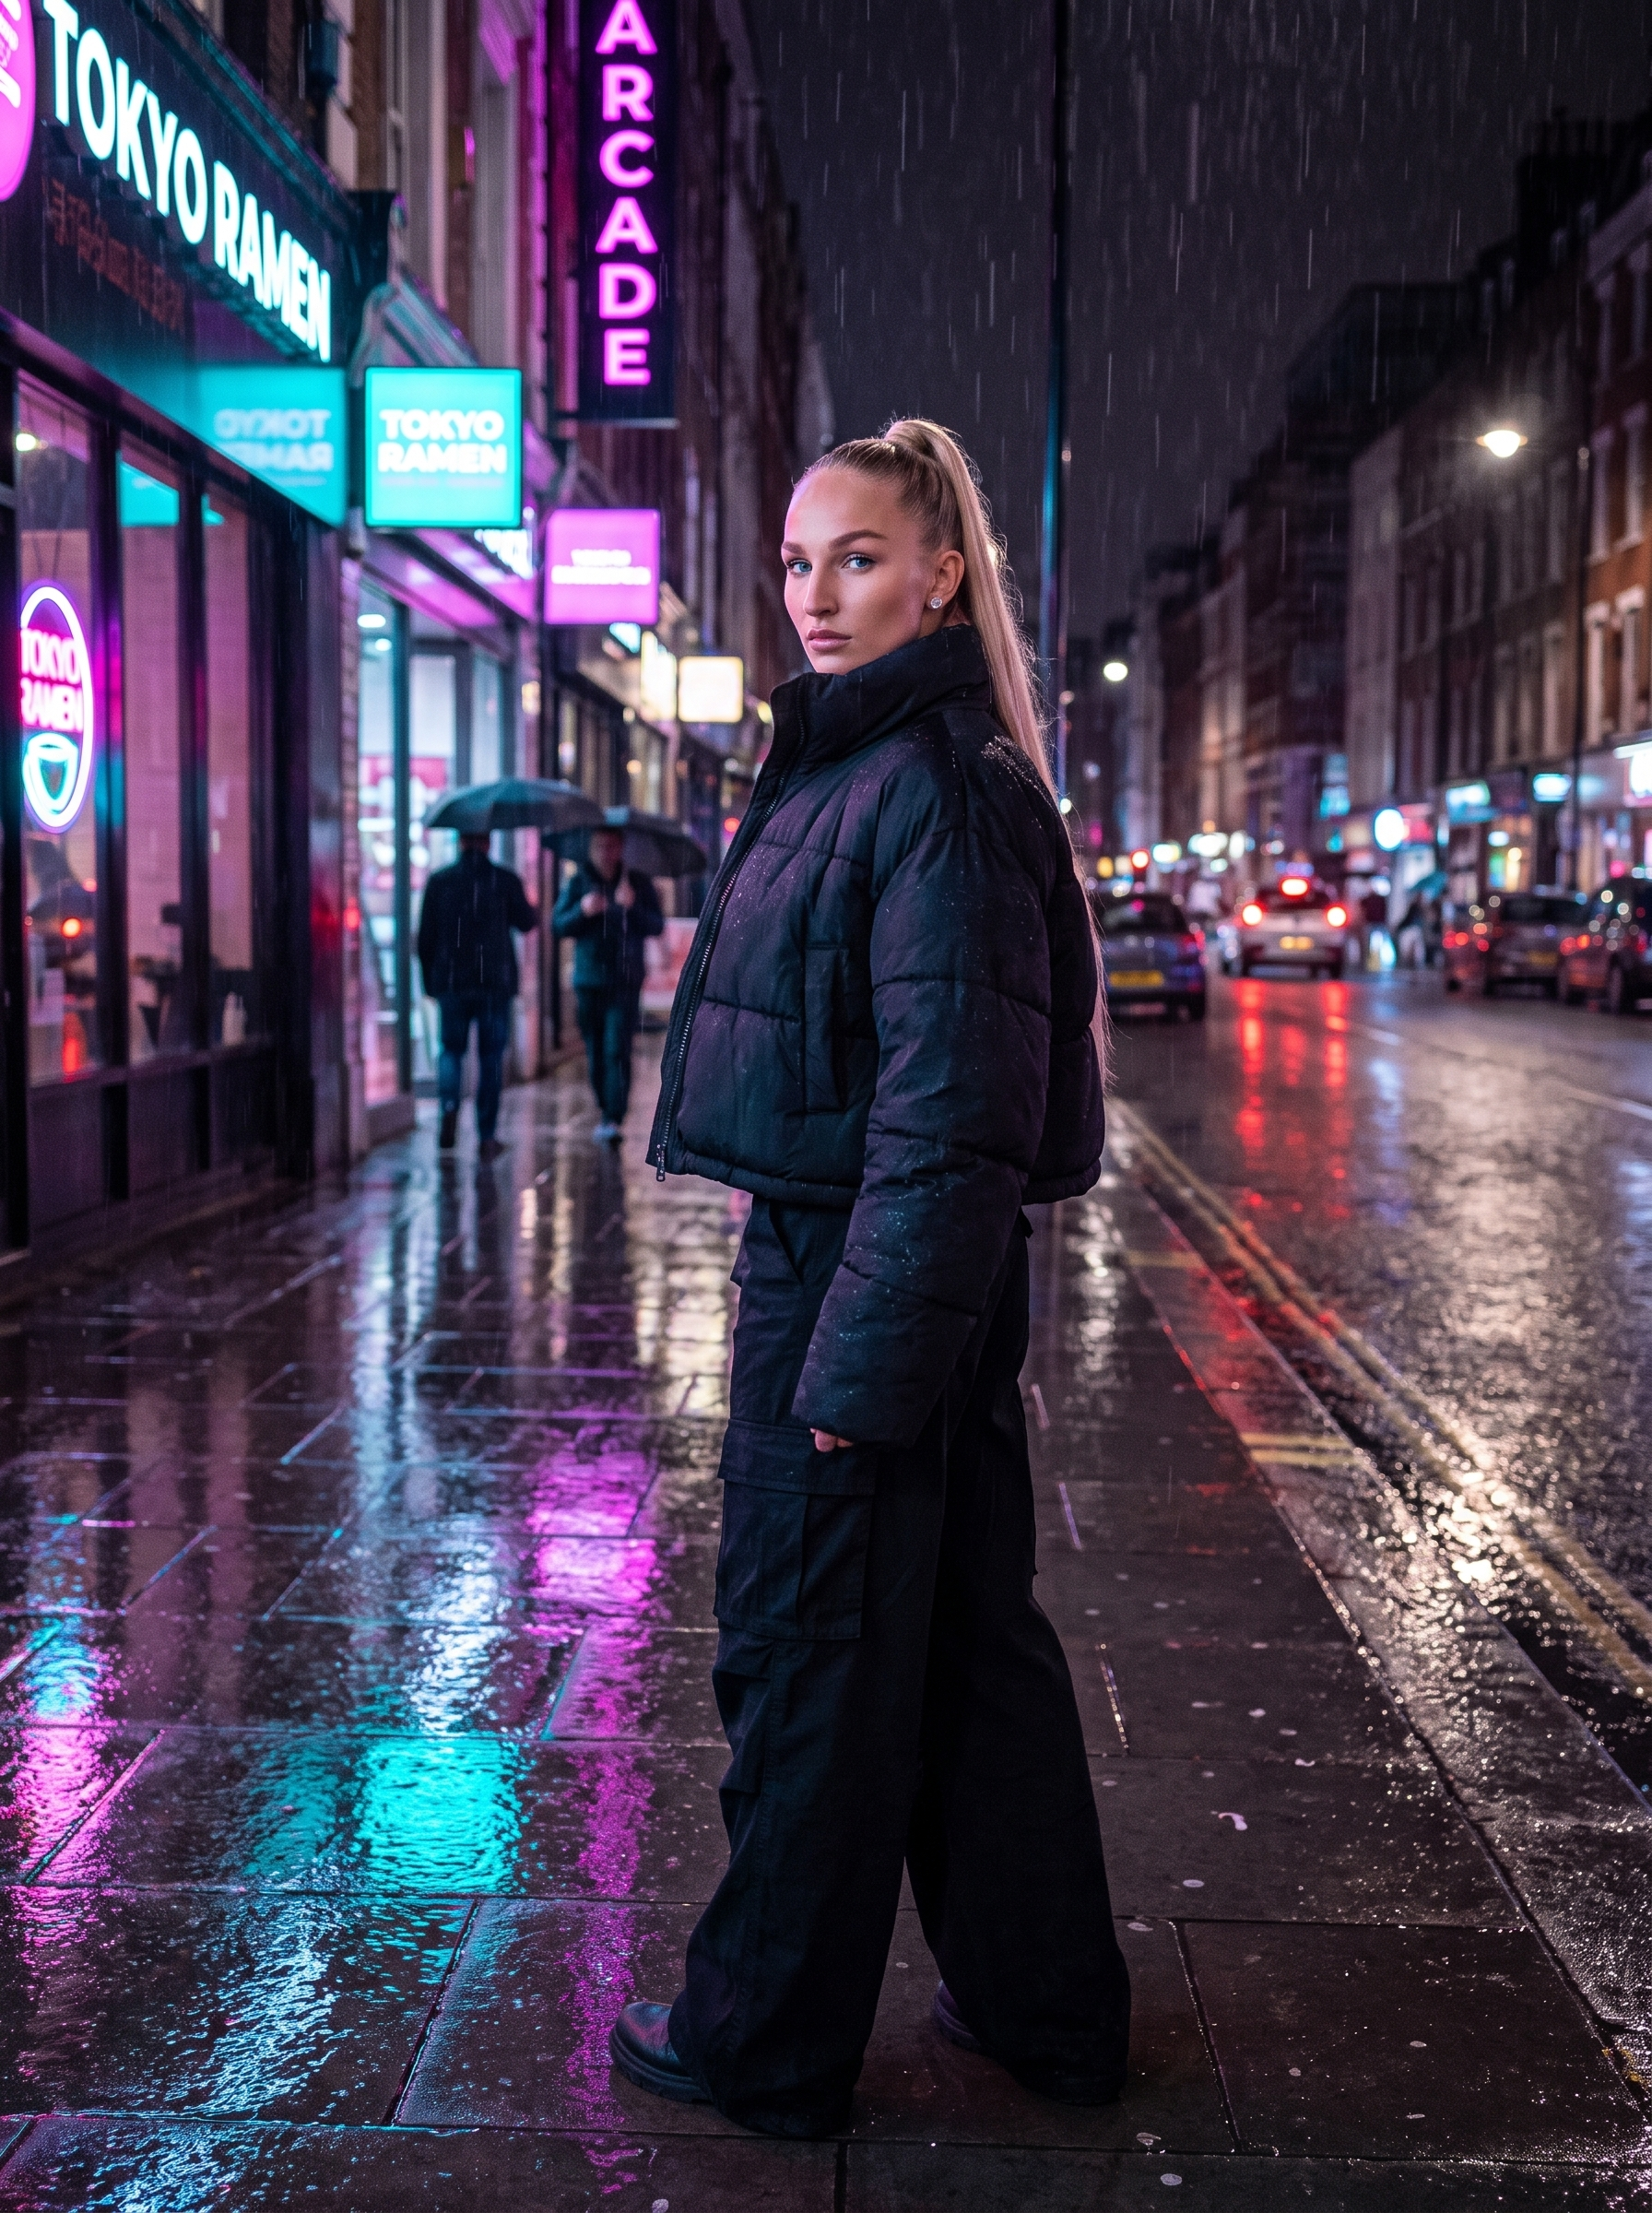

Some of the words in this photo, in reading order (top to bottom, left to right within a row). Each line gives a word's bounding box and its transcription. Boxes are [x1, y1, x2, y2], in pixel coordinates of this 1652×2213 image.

[42, 0, 208, 245] TOKYO
[213, 160, 331, 363] RAMEN
[595, 0, 658, 385] ARCADE
[377, 442, 507, 474] RAMEN
[379, 408, 505, 442] TOKYO
